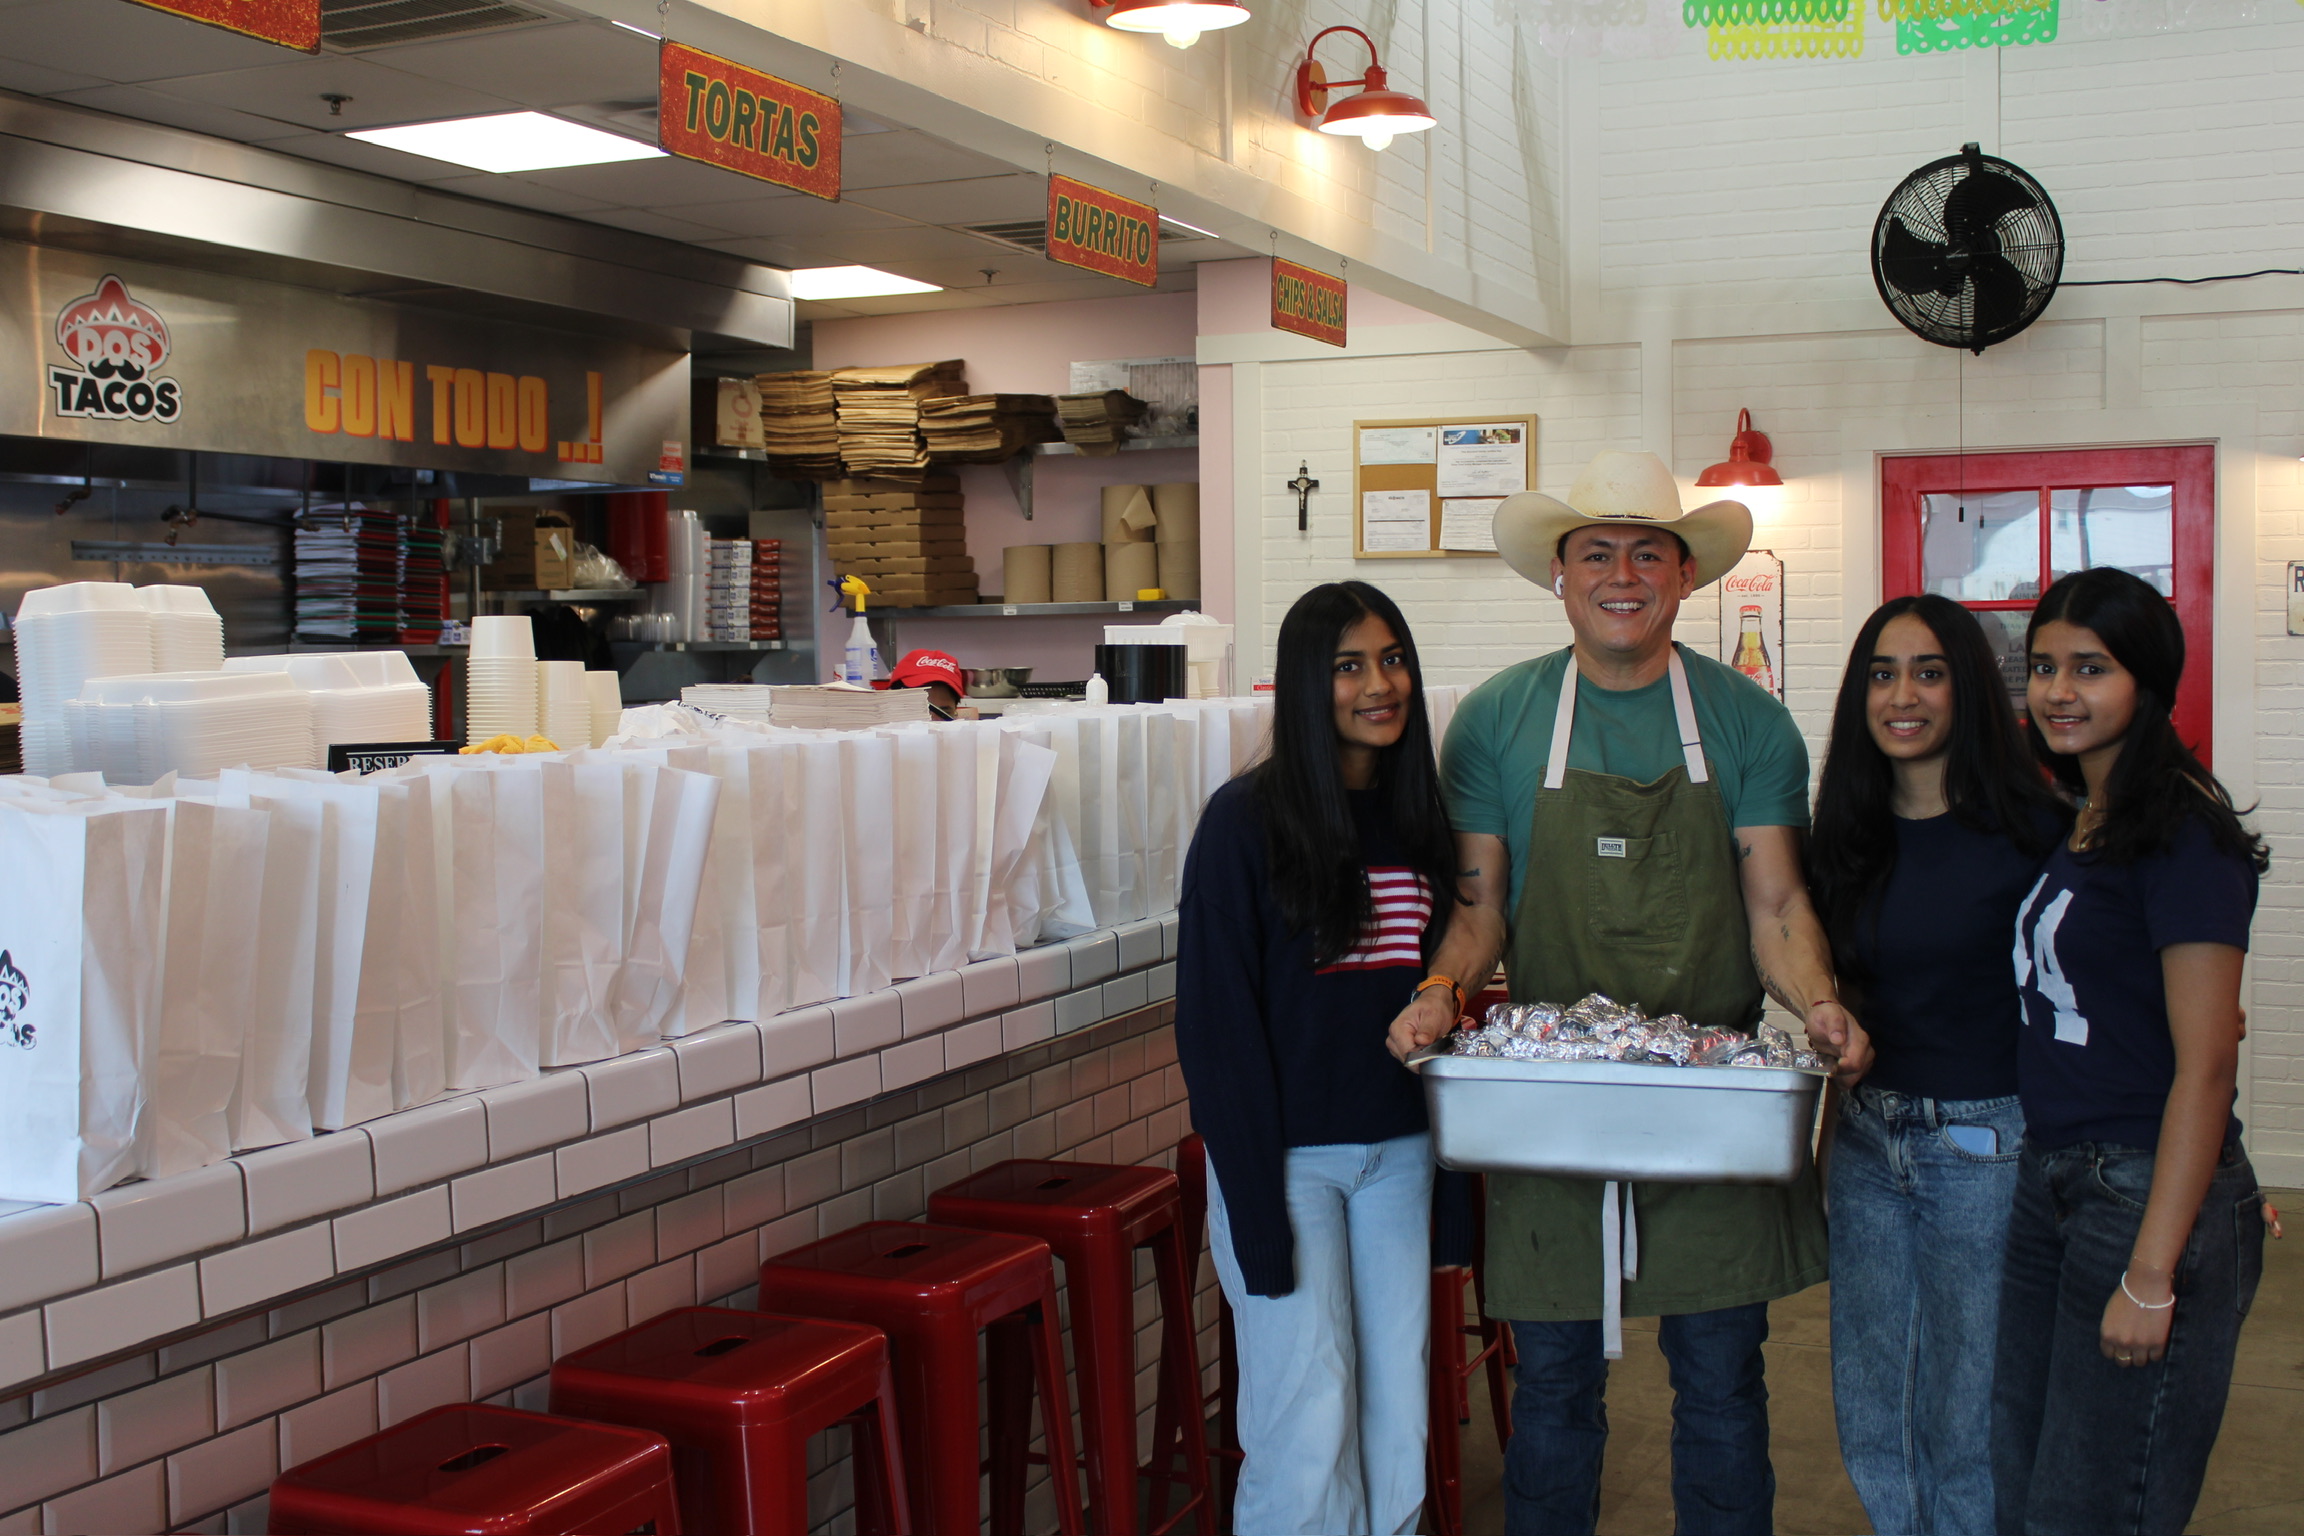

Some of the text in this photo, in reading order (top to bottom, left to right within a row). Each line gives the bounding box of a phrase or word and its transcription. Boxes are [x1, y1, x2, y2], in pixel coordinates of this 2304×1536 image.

[685, 69, 820, 170] TORTAS
[1053, 193, 1151, 267] BURRITO
[1276, 272, 1344, 331] CHIPS & SALSA
[77, 327, 153, 366] DOS
[53, 371, 178, 418] TACOS
[304, 348, 415, 442] CON
[426, 364, 548, 453] TODO
[1725, 574, 1776, 592] Coca-Cola
[916, 655, 956, 673] Coca-Cola
